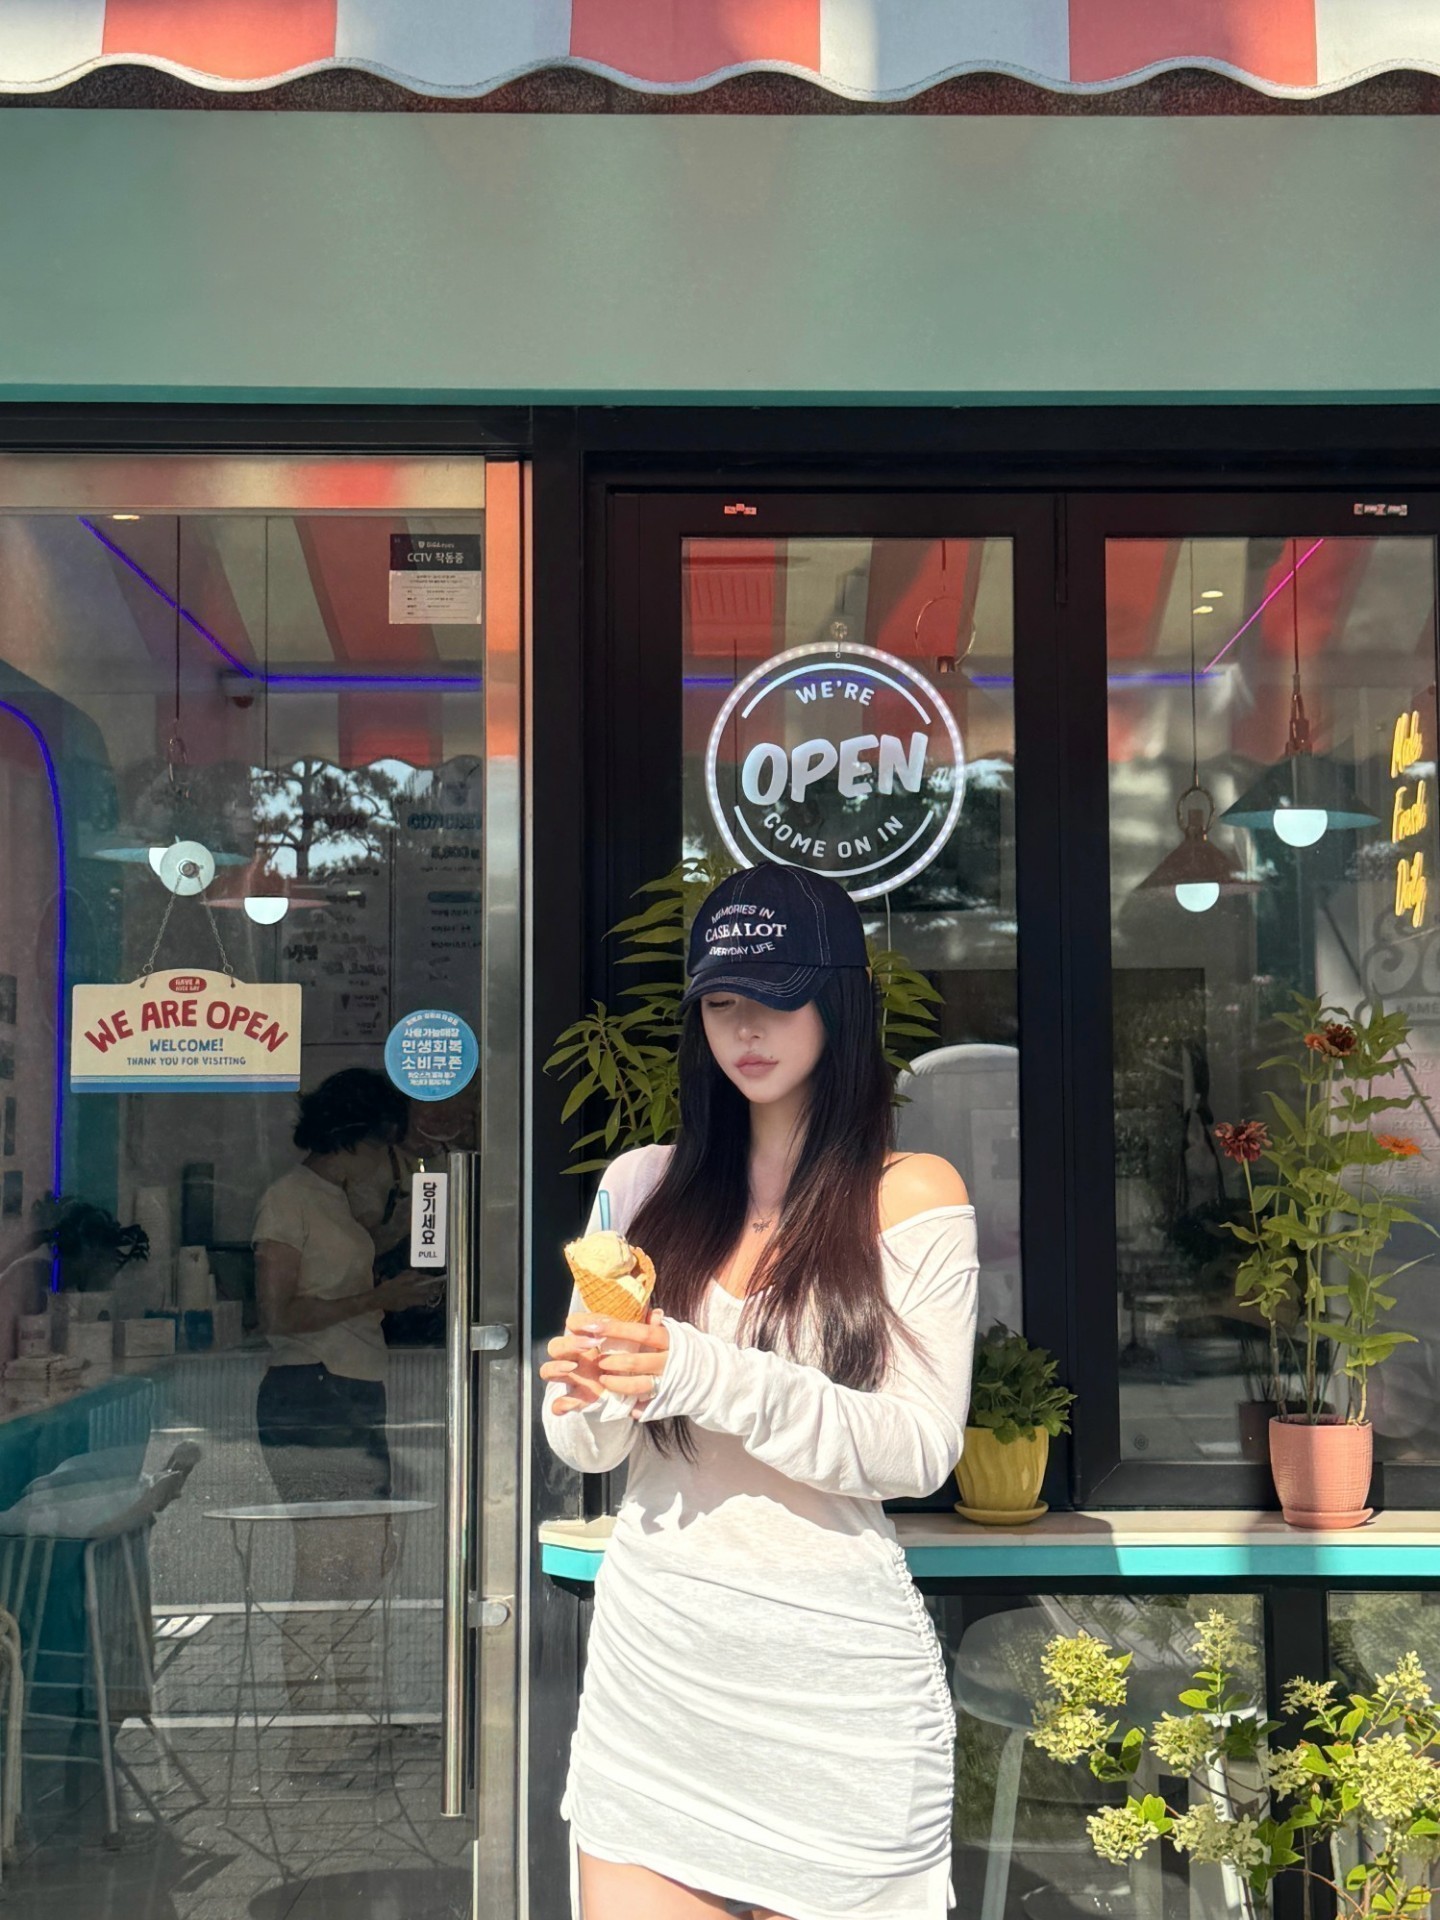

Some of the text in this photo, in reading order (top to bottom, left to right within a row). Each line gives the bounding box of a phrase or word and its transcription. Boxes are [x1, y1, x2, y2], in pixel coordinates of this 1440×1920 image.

[407, 552, 465, 564] CCTV 작동중
[741, 731, 929, 806] OPEN
[763, 811, 904, 859] COME ON IN
[711, 904, 775, 924] MEMORIES IN
[709, 941, 776, 957] EVERYDAY LIFE
[84, 1000, 289, 1054] WE ARE OPEN
[150, 1038, 224, 1052] WELCOME!
[401, 1039, 463, 1053] 민생회복
[127, 1056, 247, 1066] THANK YOU FOR VISITING
[401, 1055, 463, 1070] 소비쿠폰
[421, 1181, 437, 1245] 당기세요
[418, 1251, 437, 1259] PULL
